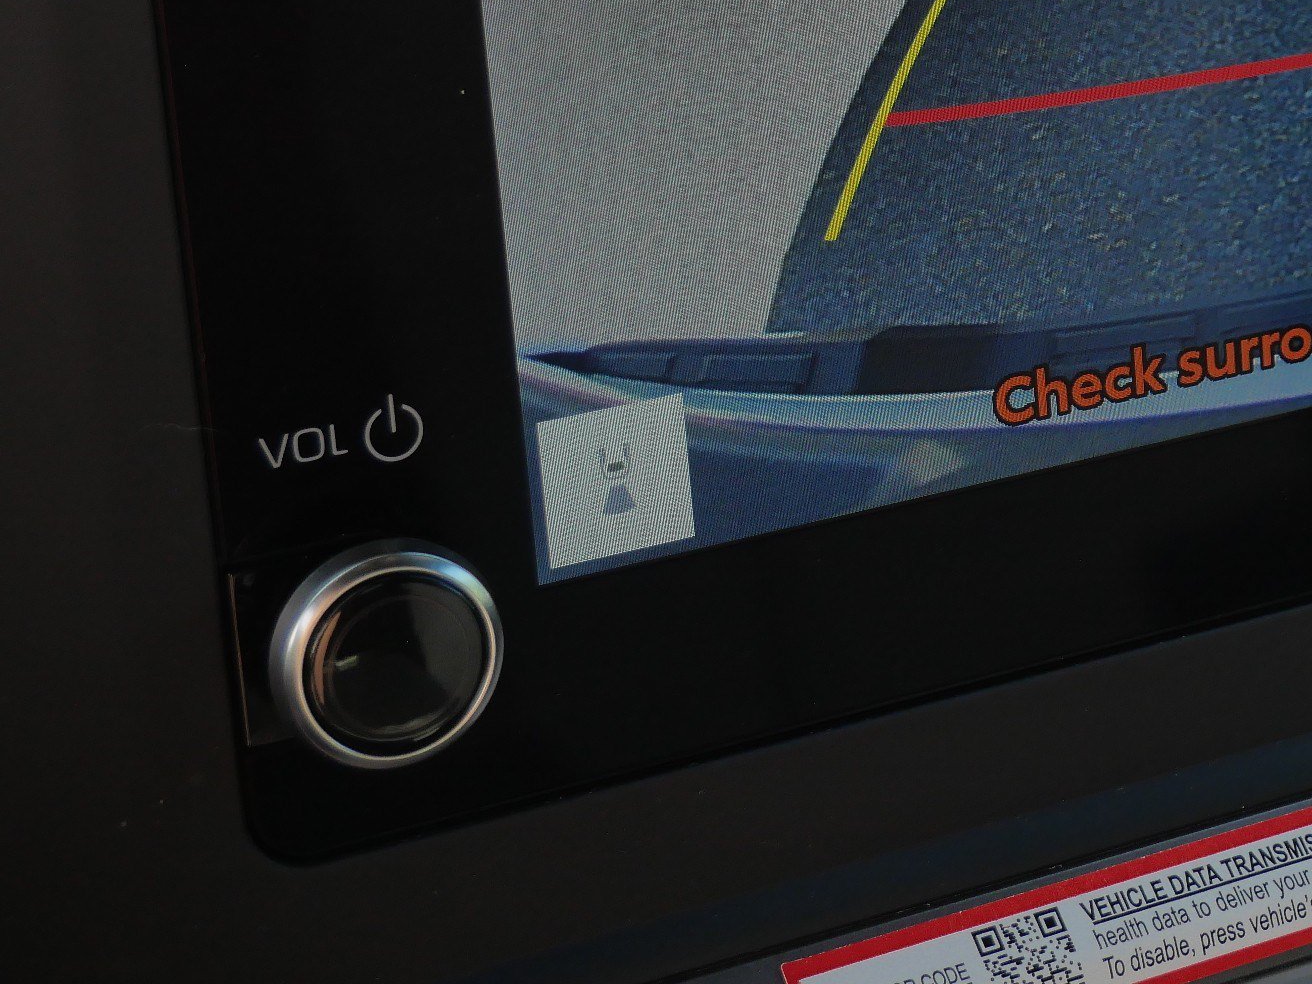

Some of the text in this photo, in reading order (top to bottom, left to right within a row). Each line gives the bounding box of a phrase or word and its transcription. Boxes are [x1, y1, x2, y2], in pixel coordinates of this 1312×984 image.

[991, 343, 1168, 428] Check
[259, 424, 348, 469] VOL
[1079, 879, 1169, 922] VEHICLE
[1167, 864, 1224, 896] DATA
[1092, 917, 1150, 950] health
[1151, 906, 1192, 932] data
[1191, 899, 1212, 920] to
[1215, 881, 1271, 912] deliver
[1273, 869, 1312, 899] your
[1102, 955, 1126, 979] To
[1130, 935, 1197, 974] disable,
[1199, 920, 1246, 956] press
